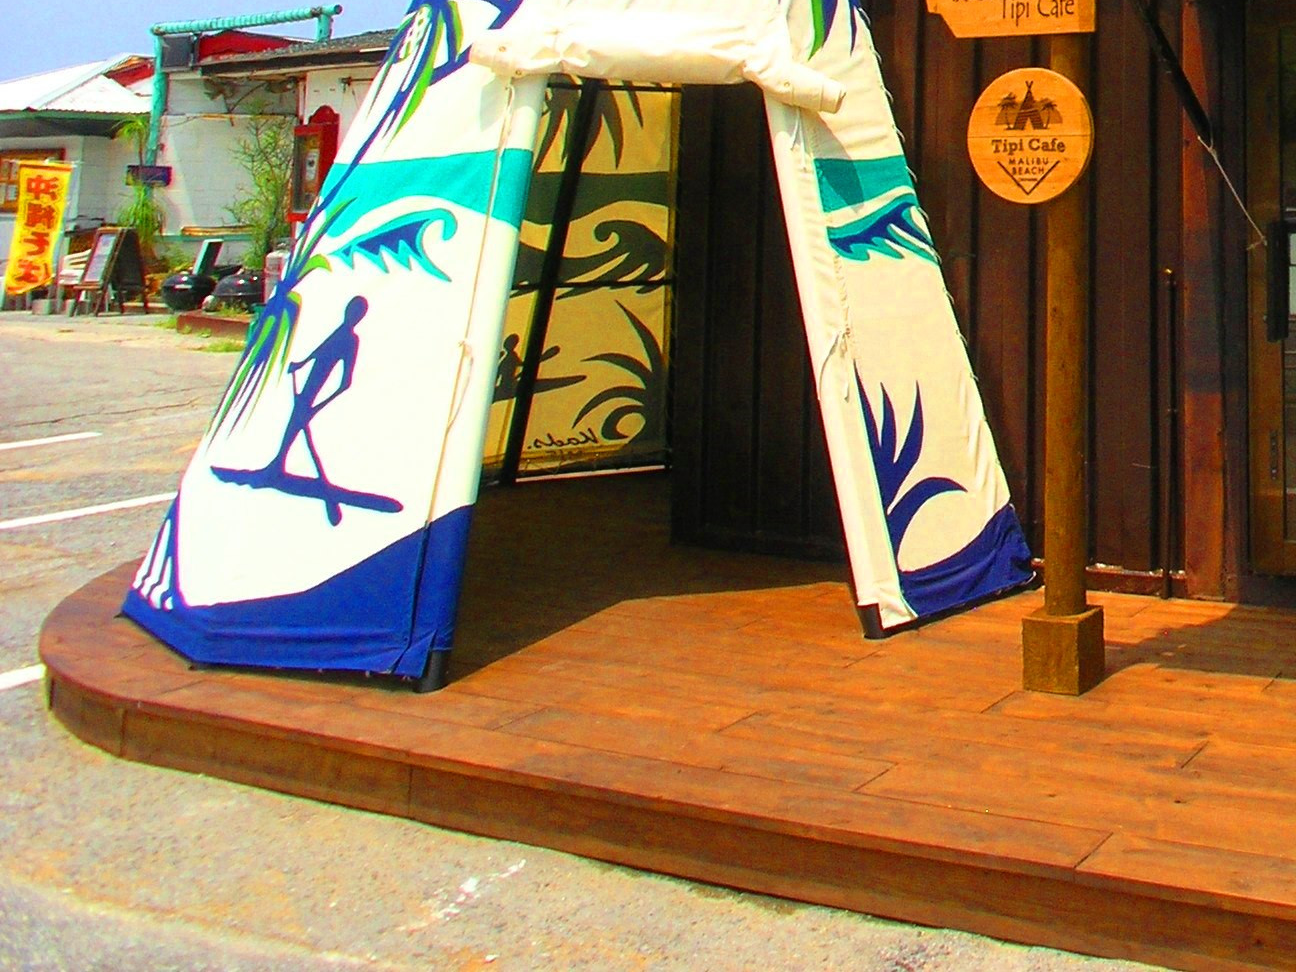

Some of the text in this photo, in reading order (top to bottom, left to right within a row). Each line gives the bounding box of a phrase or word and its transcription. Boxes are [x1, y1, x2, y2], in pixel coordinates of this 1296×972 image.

[991, 137, 1066, 156] Tipi Cafe
[1008, 157, 1049, 165] MALIBU
[1012, 166, 1044, 175] BEACH
